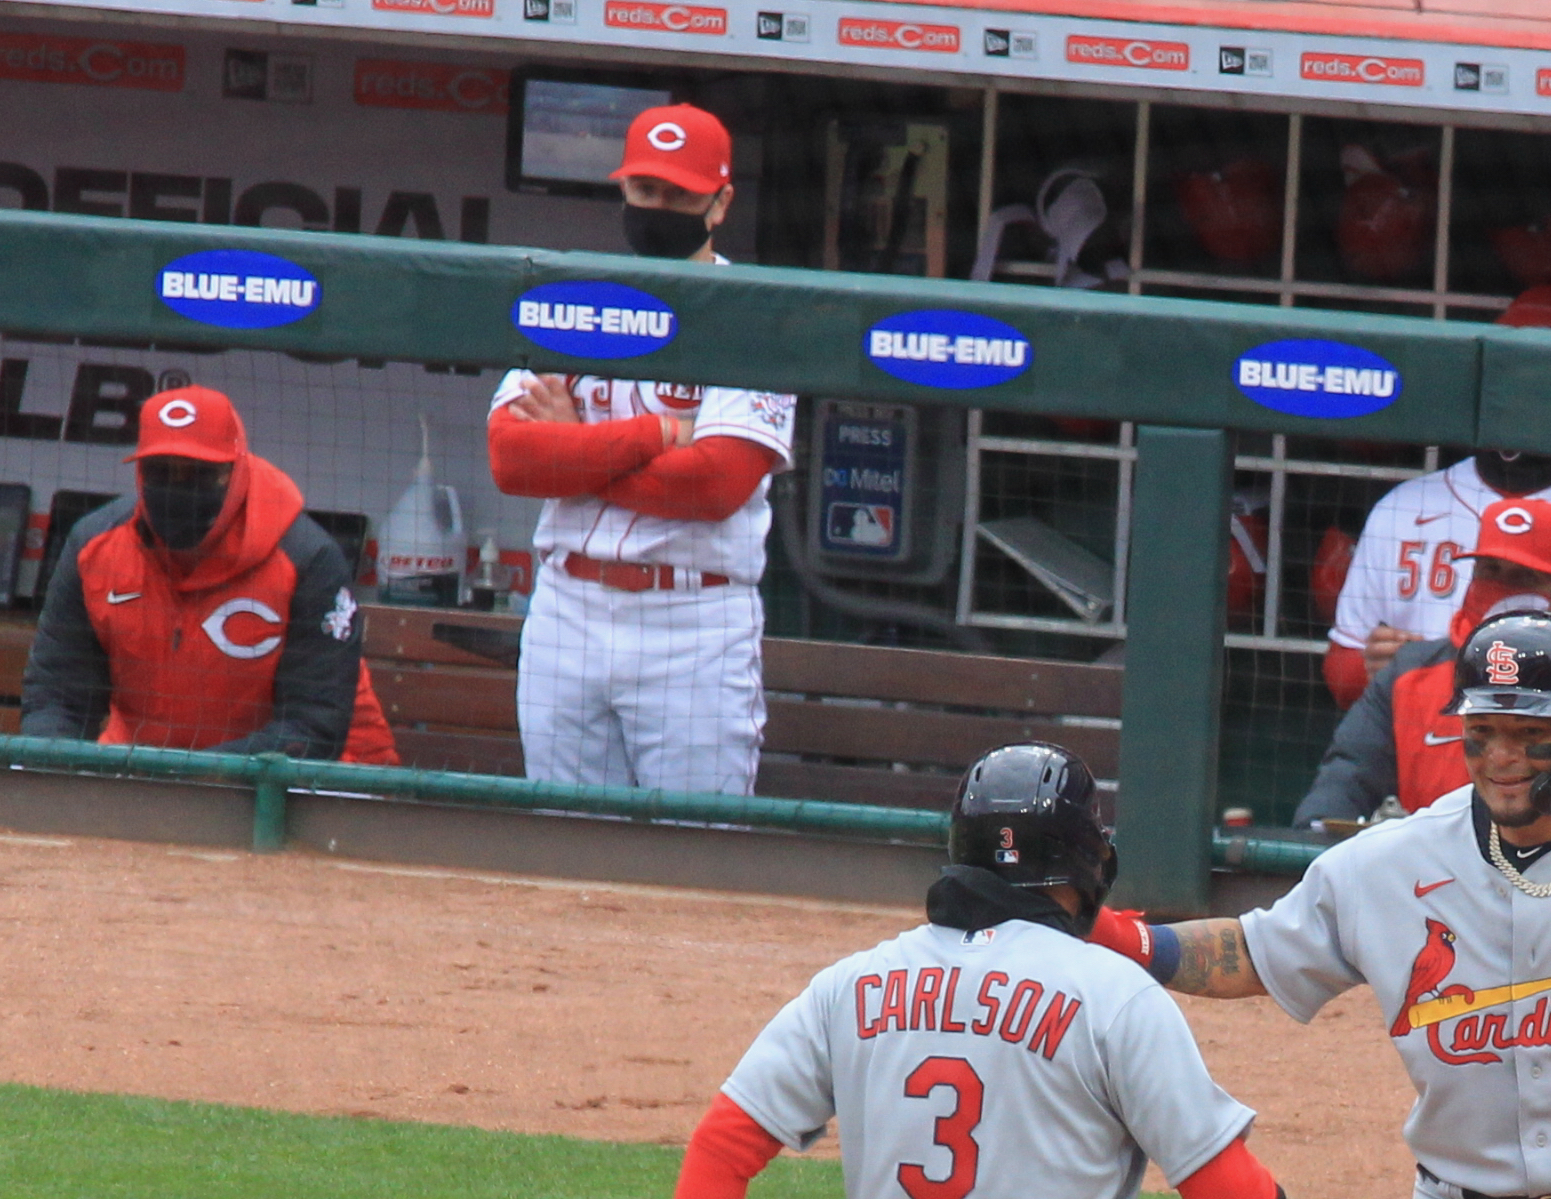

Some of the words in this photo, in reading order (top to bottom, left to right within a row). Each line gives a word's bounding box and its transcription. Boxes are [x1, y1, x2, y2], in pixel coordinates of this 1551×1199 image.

[0, 43, 178, 82] eds.Com
[162, 270, 313, 307] BLUE-EMU
[519, 300, 670, 338] BLUE-EMU
[870, 330, 1026, 368] BLUE-EMU
[1239, 361, 1395, 398] BLUE-EMU
[838, 424, 893, 447] PRESS
[1399, 540, 1458, 598] 56
[1000, 827, 1013, 849] 3
[855, 966, 1082, 1061] CARLSON
